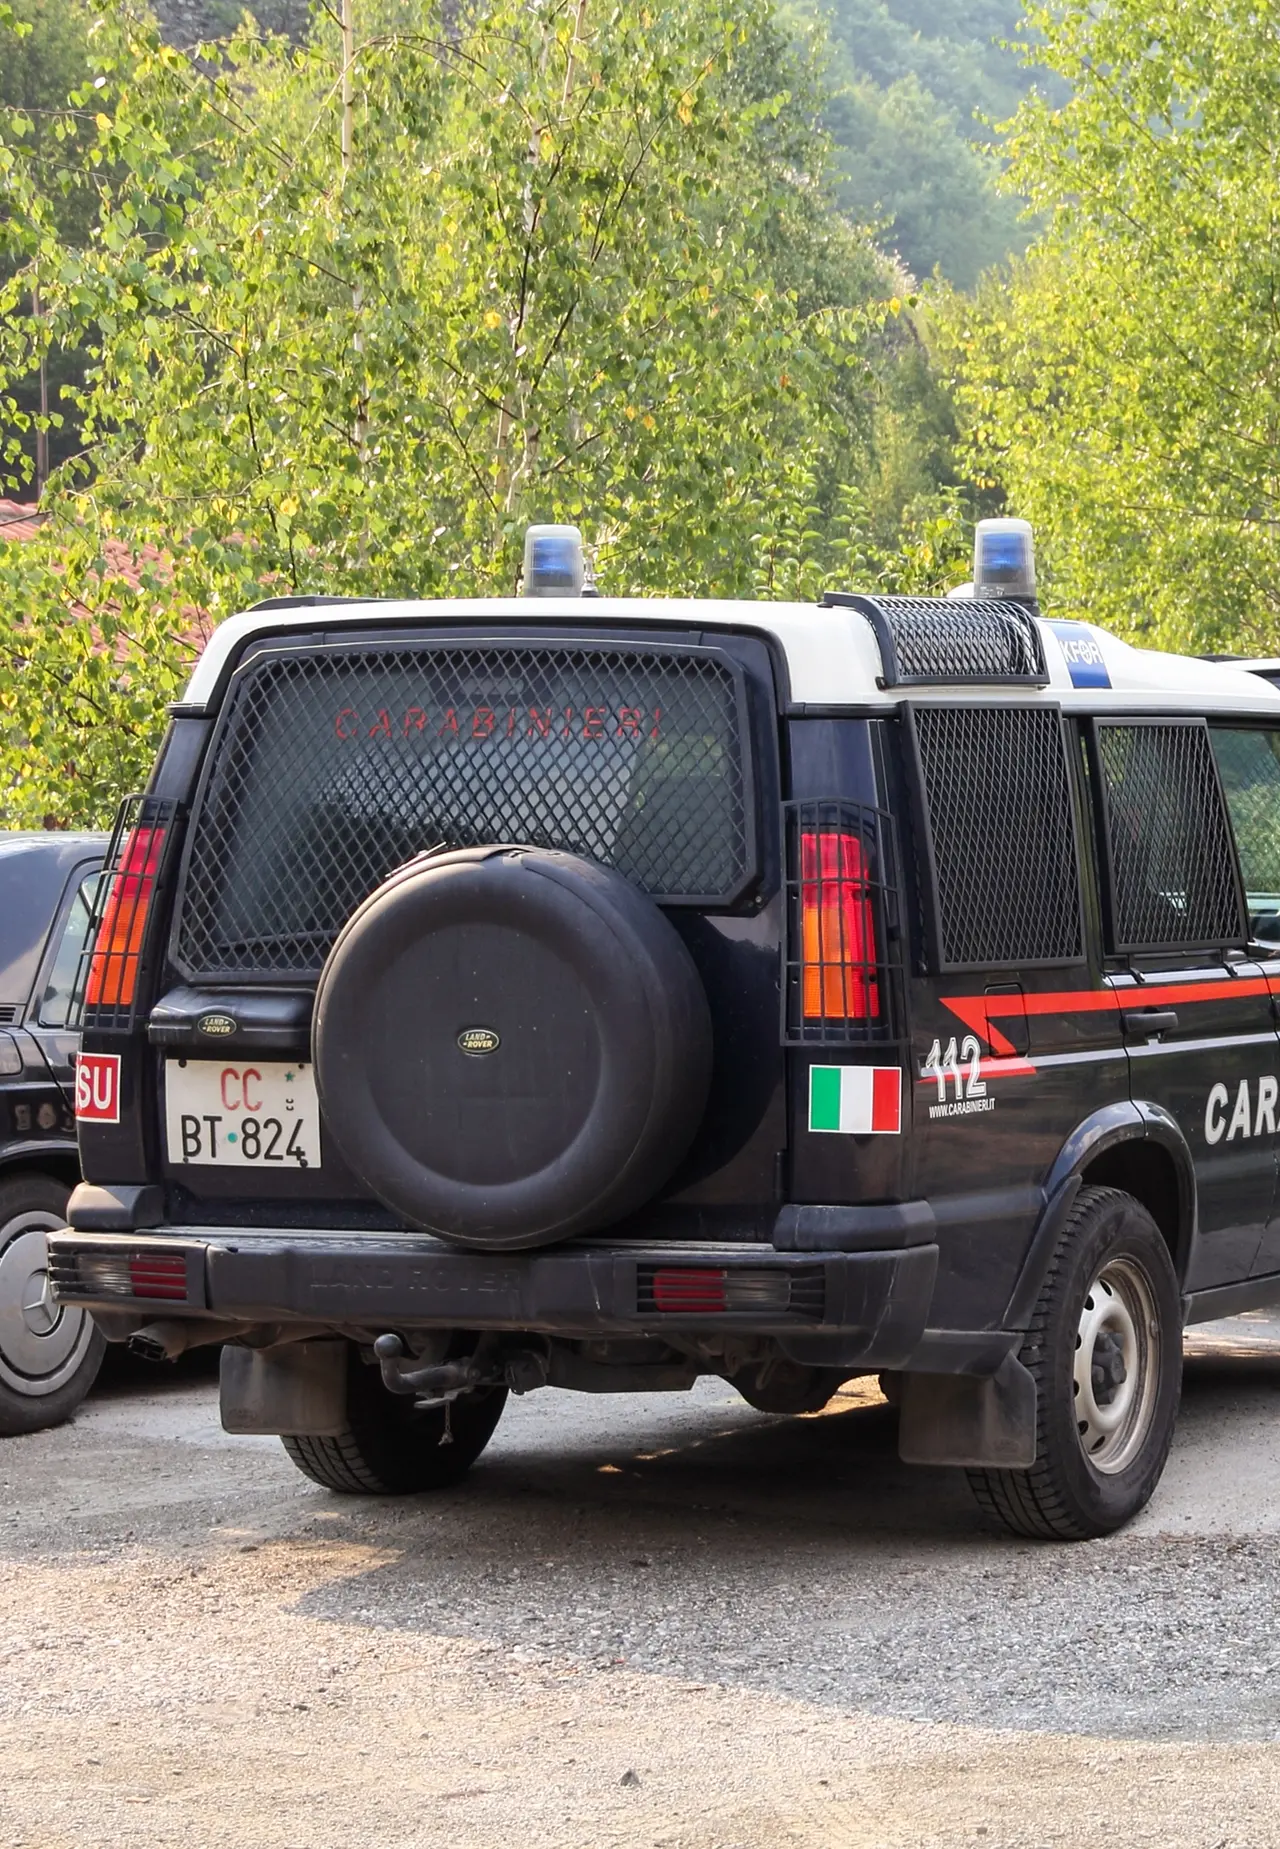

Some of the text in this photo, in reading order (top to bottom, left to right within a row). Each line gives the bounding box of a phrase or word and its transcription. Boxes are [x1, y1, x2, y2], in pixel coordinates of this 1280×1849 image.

[335, 707, 661, 739] CARABINIERI
[204, 1018, 225, 1026] LAND
[465, 1033, 486, 1041] LAND
[467, 1040, 493, 1048] ROVER
[77, 1063, 113, 1110] SU
[925, 1034, 987, 1102] 112
[220, 1067, 263, 1112] CC
[180, 1114, 306, 1161] BT 824
